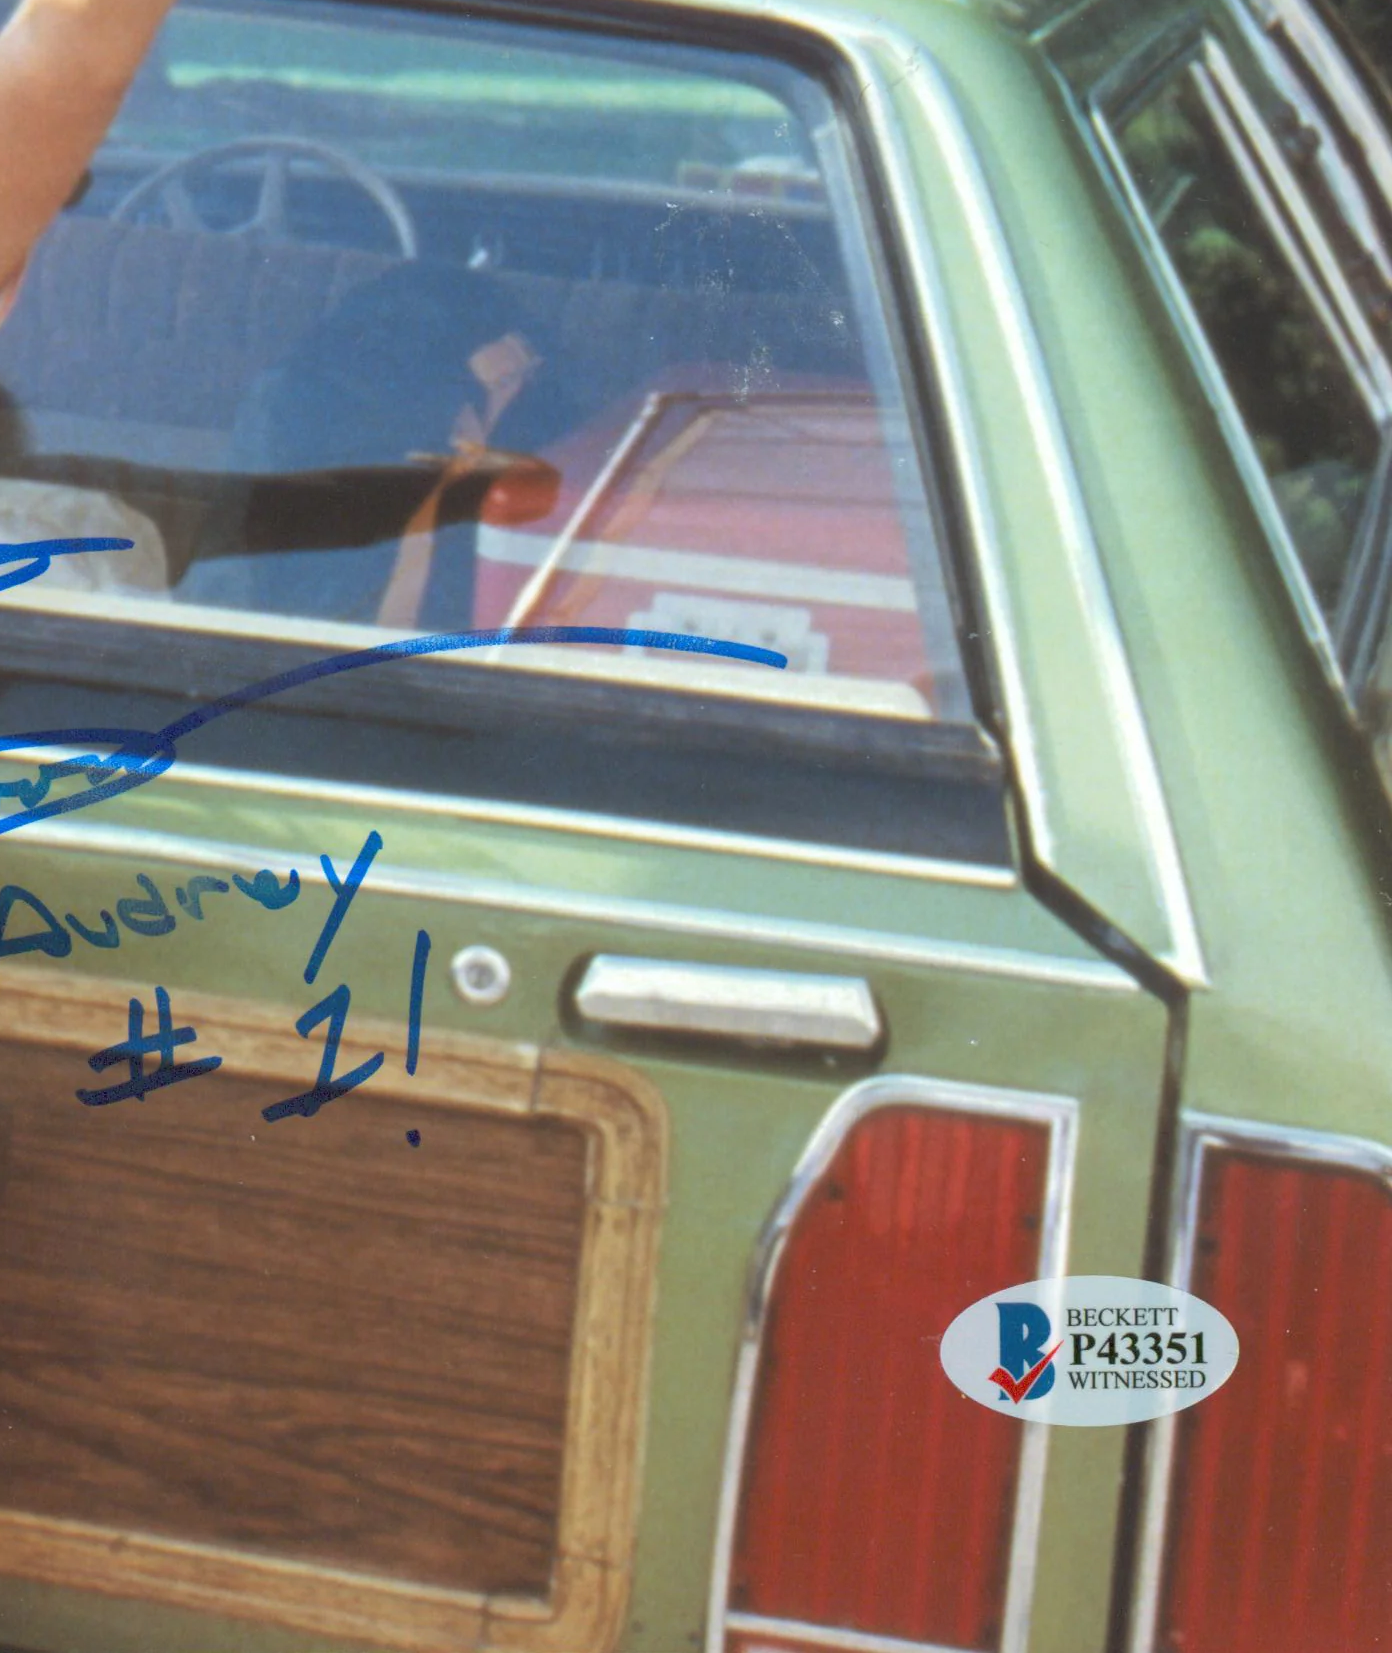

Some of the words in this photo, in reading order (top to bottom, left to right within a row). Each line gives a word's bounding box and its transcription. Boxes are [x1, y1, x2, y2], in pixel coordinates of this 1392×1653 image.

[1065, 1307, 1180, 1328] BECKETT
[1068, 1330, 1209, 1367] P43351
[1068, 1369, 1207, 1390] WITNESSED
